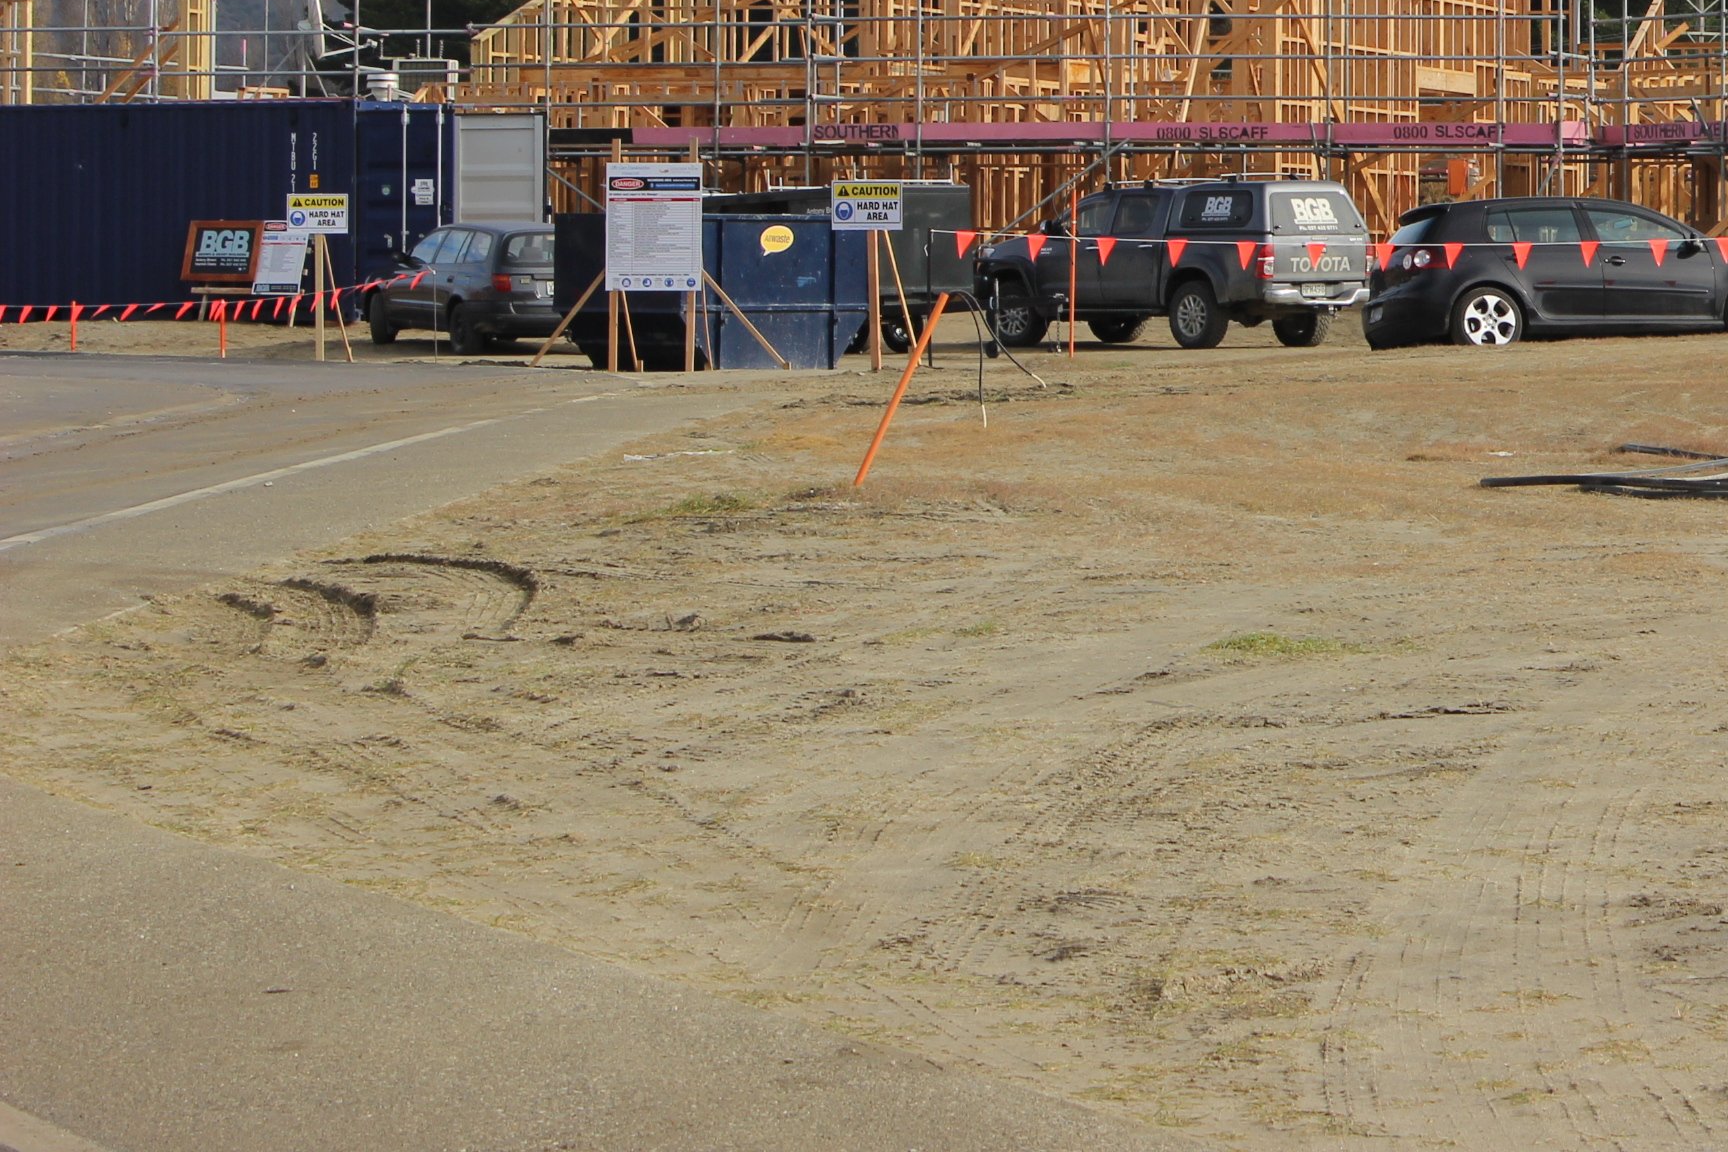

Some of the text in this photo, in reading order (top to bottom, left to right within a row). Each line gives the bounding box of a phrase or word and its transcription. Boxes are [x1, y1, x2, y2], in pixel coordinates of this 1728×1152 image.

[814, 124, 899, 139] SOUTHERN
[1156, 126, 1269, 140] 0800 SLSCAFF
[1393, 125, 1506, 139] 0800 SLSCAFF
[1634, 124, 1686, 140] SOUTHERN
[851, 186, 898, 196] CAUTION
[304, 198, 345, 206] CAUTION
[857, 201, 899, 210] HARD HAT
[1204, 196, 1233, 213] BGB
[1290, 197, 1334, 221] BGB
[309, 210, 345, 218] HARD HAT
[867, 212, 889, 220] AREA
[317, 219, 336, 227] AREA
[200, 230, 250, 253] BGB
